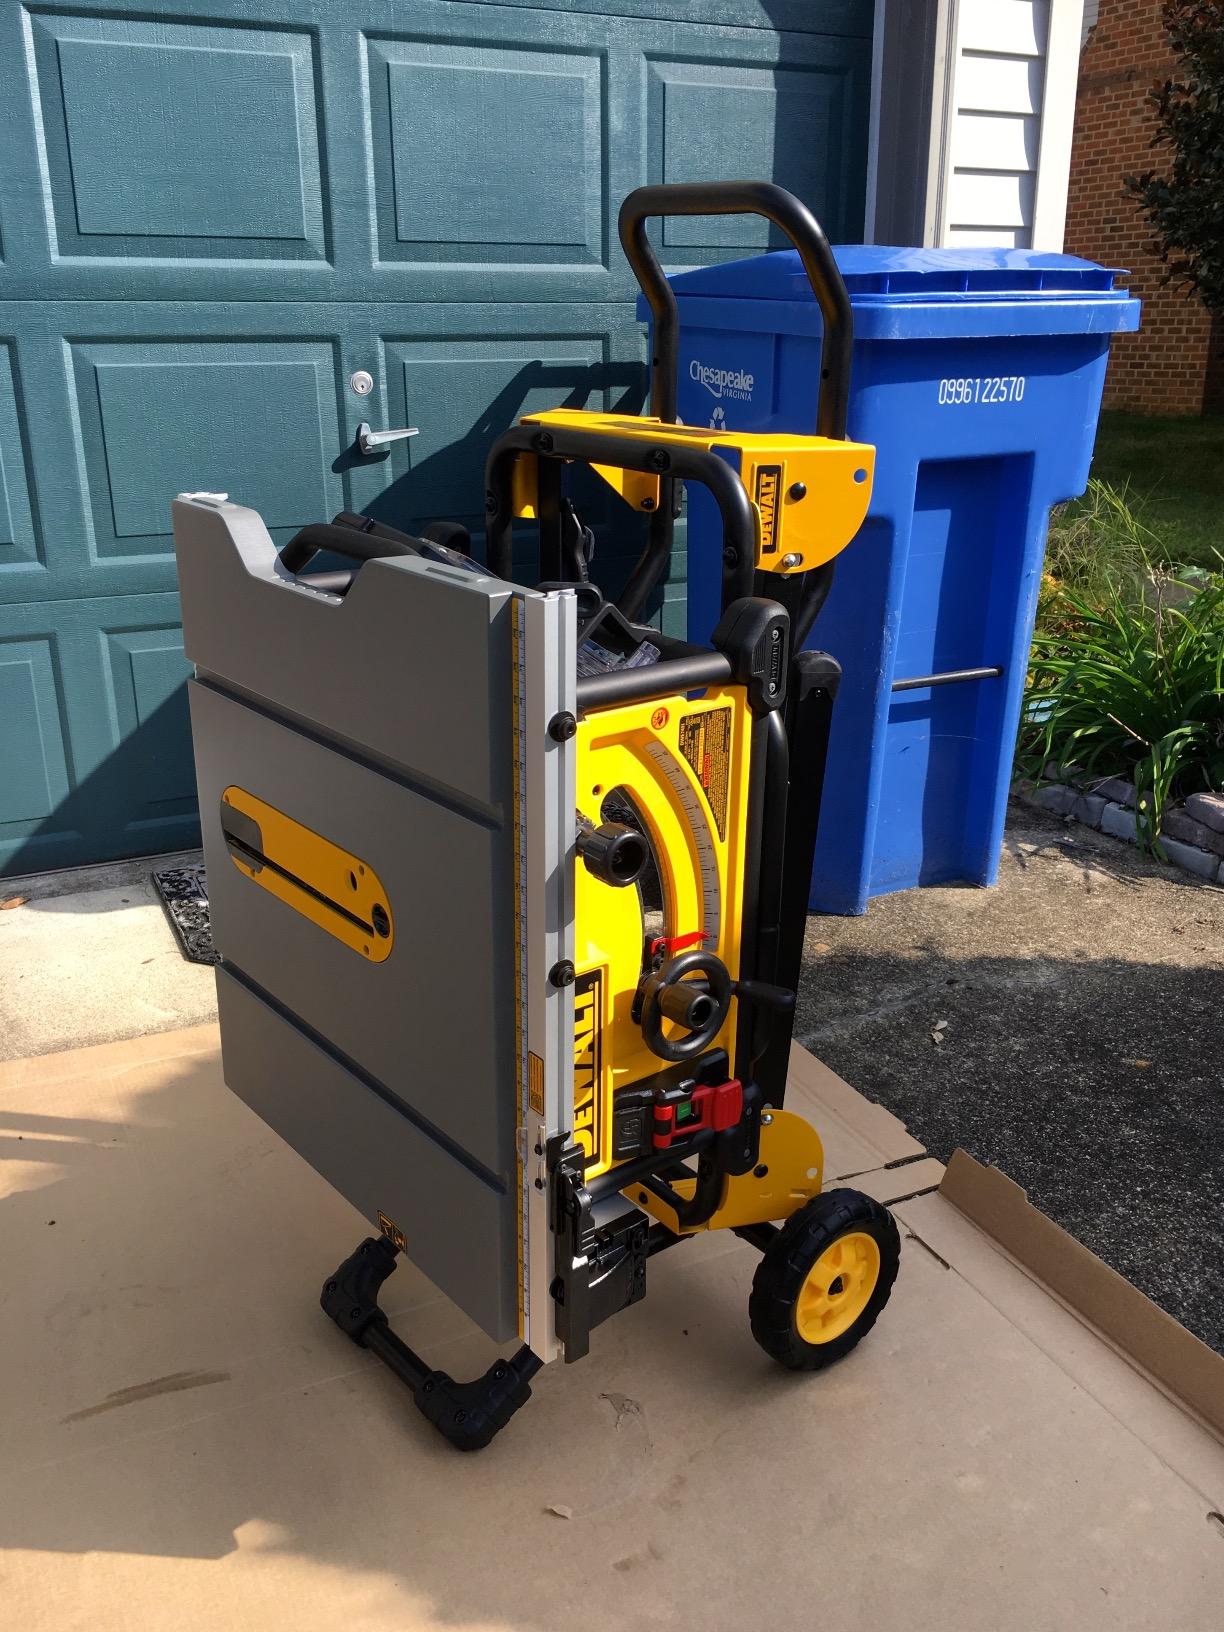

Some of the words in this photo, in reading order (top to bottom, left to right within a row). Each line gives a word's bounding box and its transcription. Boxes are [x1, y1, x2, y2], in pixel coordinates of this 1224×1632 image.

[689, 360, 754, 395] Chesapeake
[938, 376, 1025, 404] 0996122570
[722, 388, 752, 402] VIRGINIA
[760, 473, 776, 546] DEWALT
